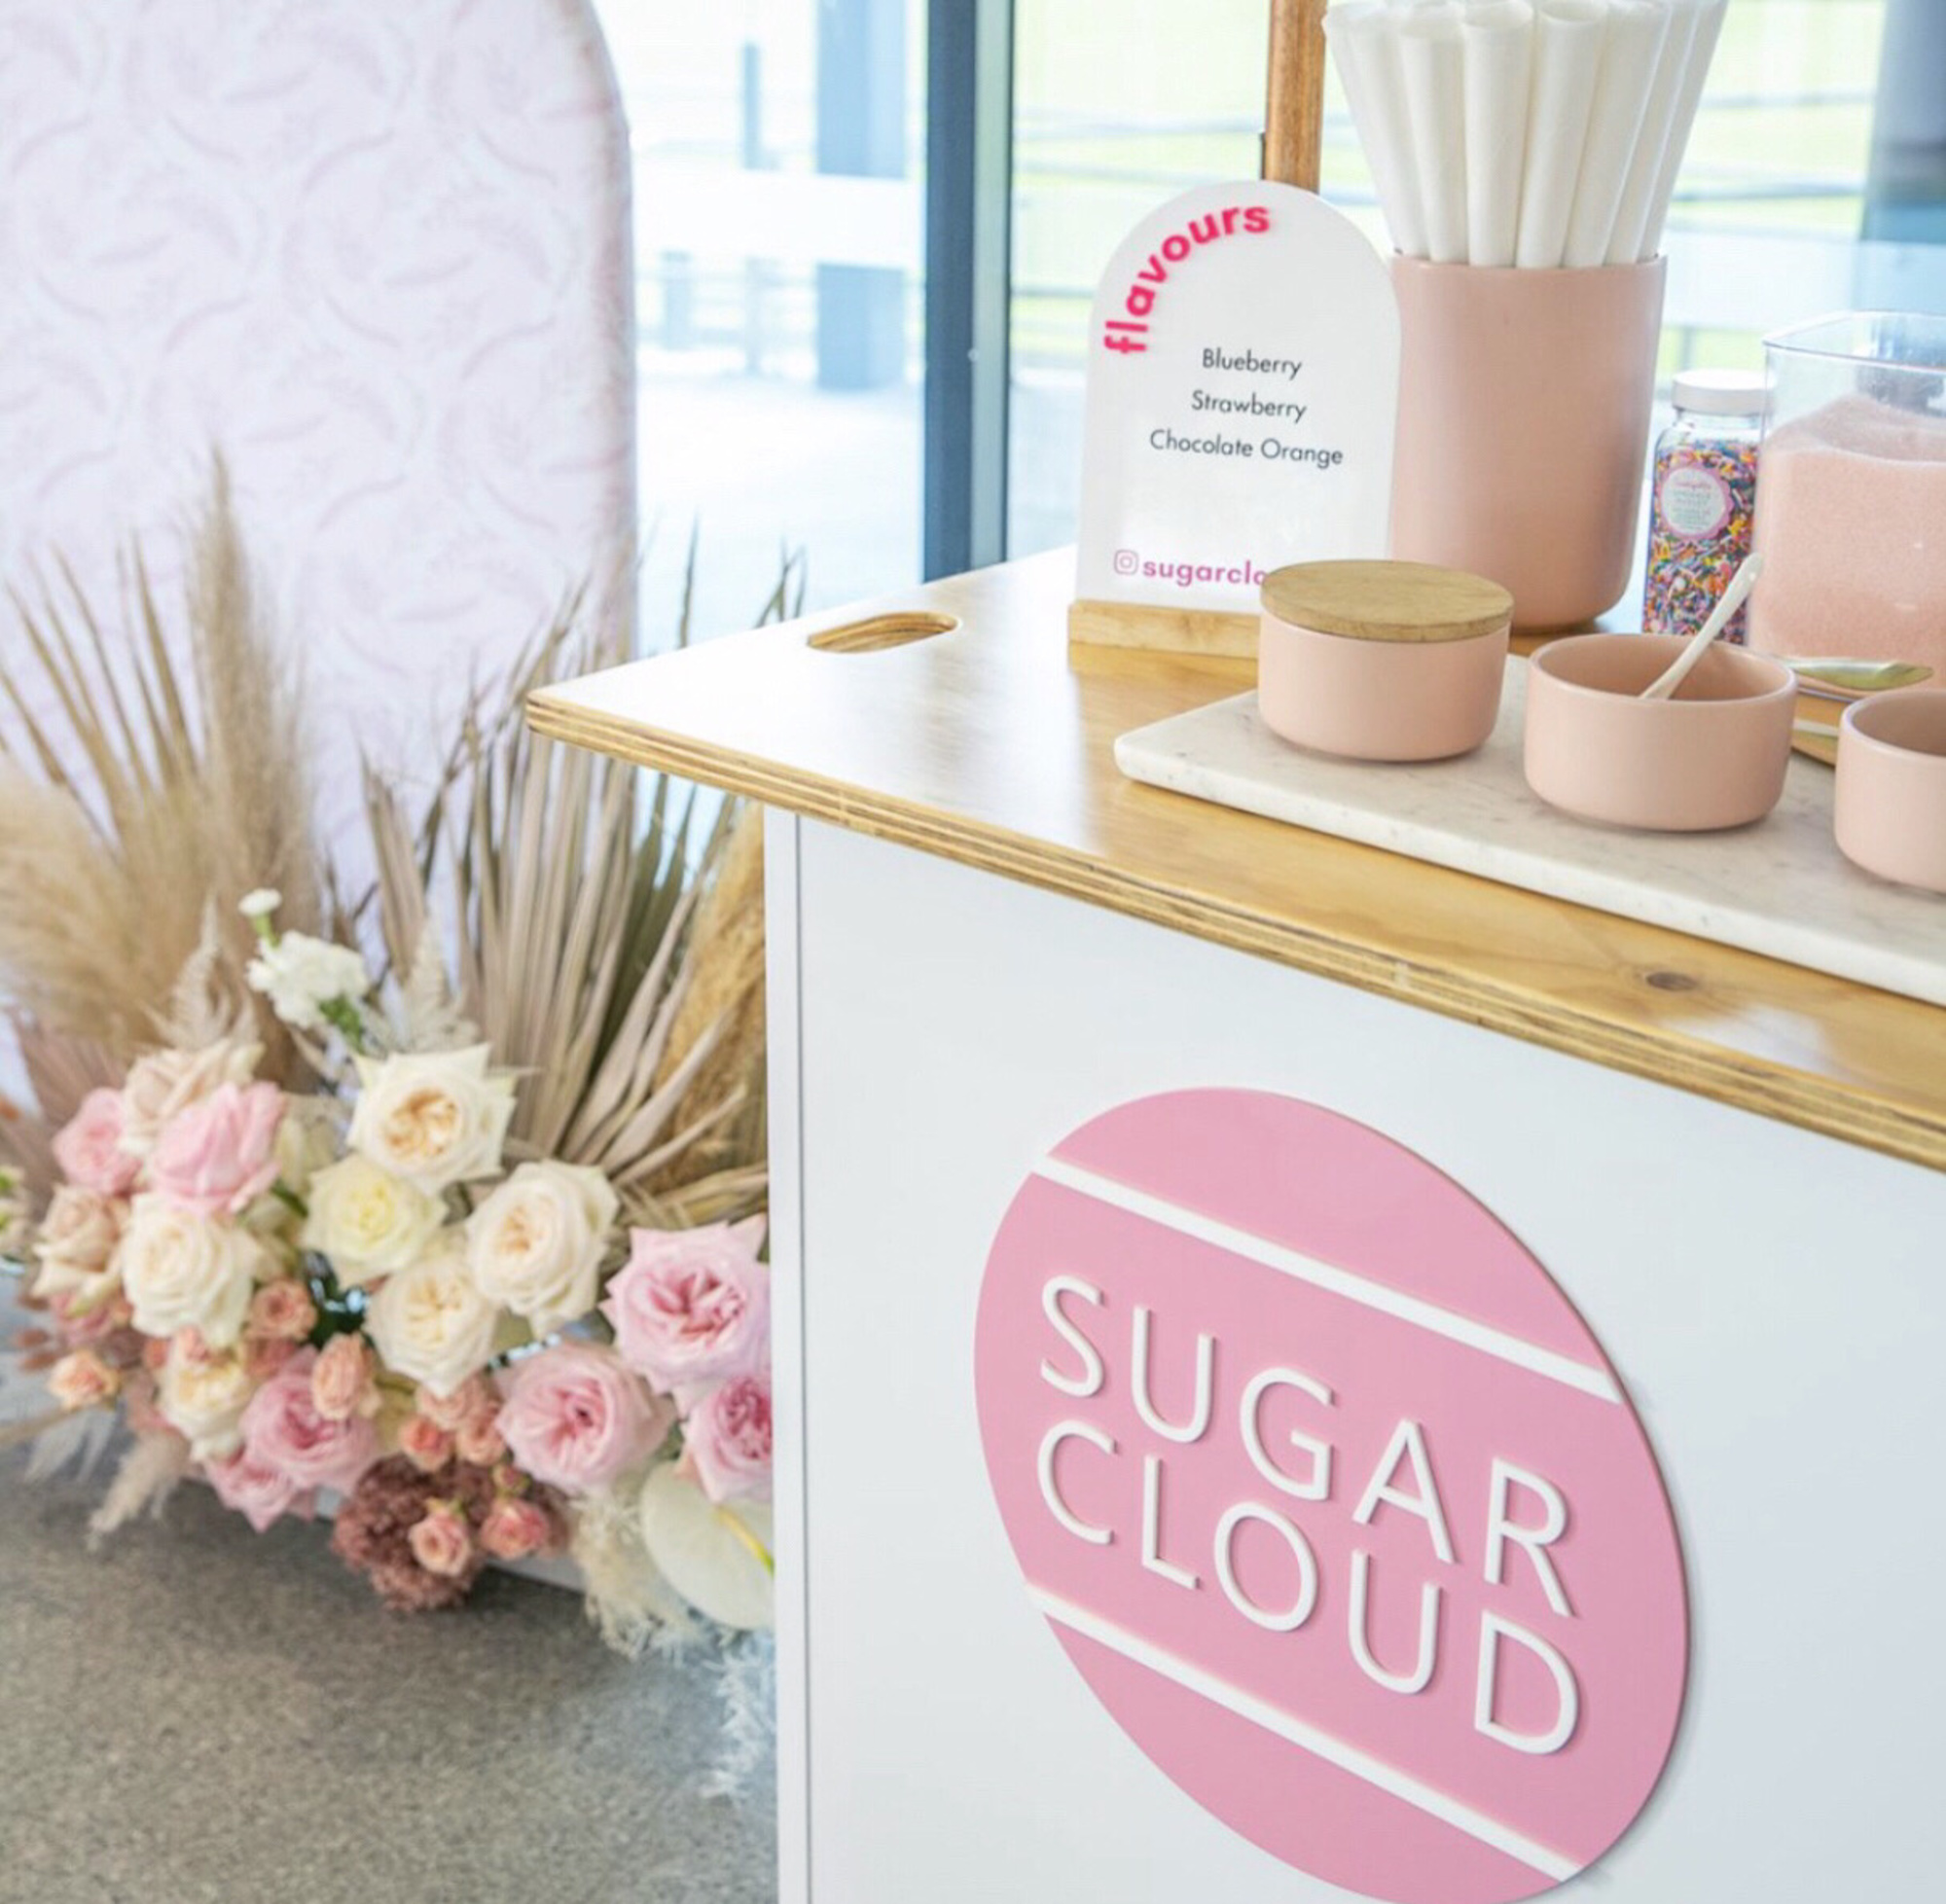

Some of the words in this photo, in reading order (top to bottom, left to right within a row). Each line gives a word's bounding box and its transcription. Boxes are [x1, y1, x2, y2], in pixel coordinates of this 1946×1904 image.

[1104, 205, 1271, 354] flavours
[1191, 390, 1307, 423] Strawberry
[1202, 347, 1302, 379] Blueberry
[1149, 429, 1253, 457] Chocolate
[1260, 439, 1343, 469] Orange
[1041, 1275, 1578, 1617] SUGAR
[1037, 1419, 1581, 1755] CLOUD
